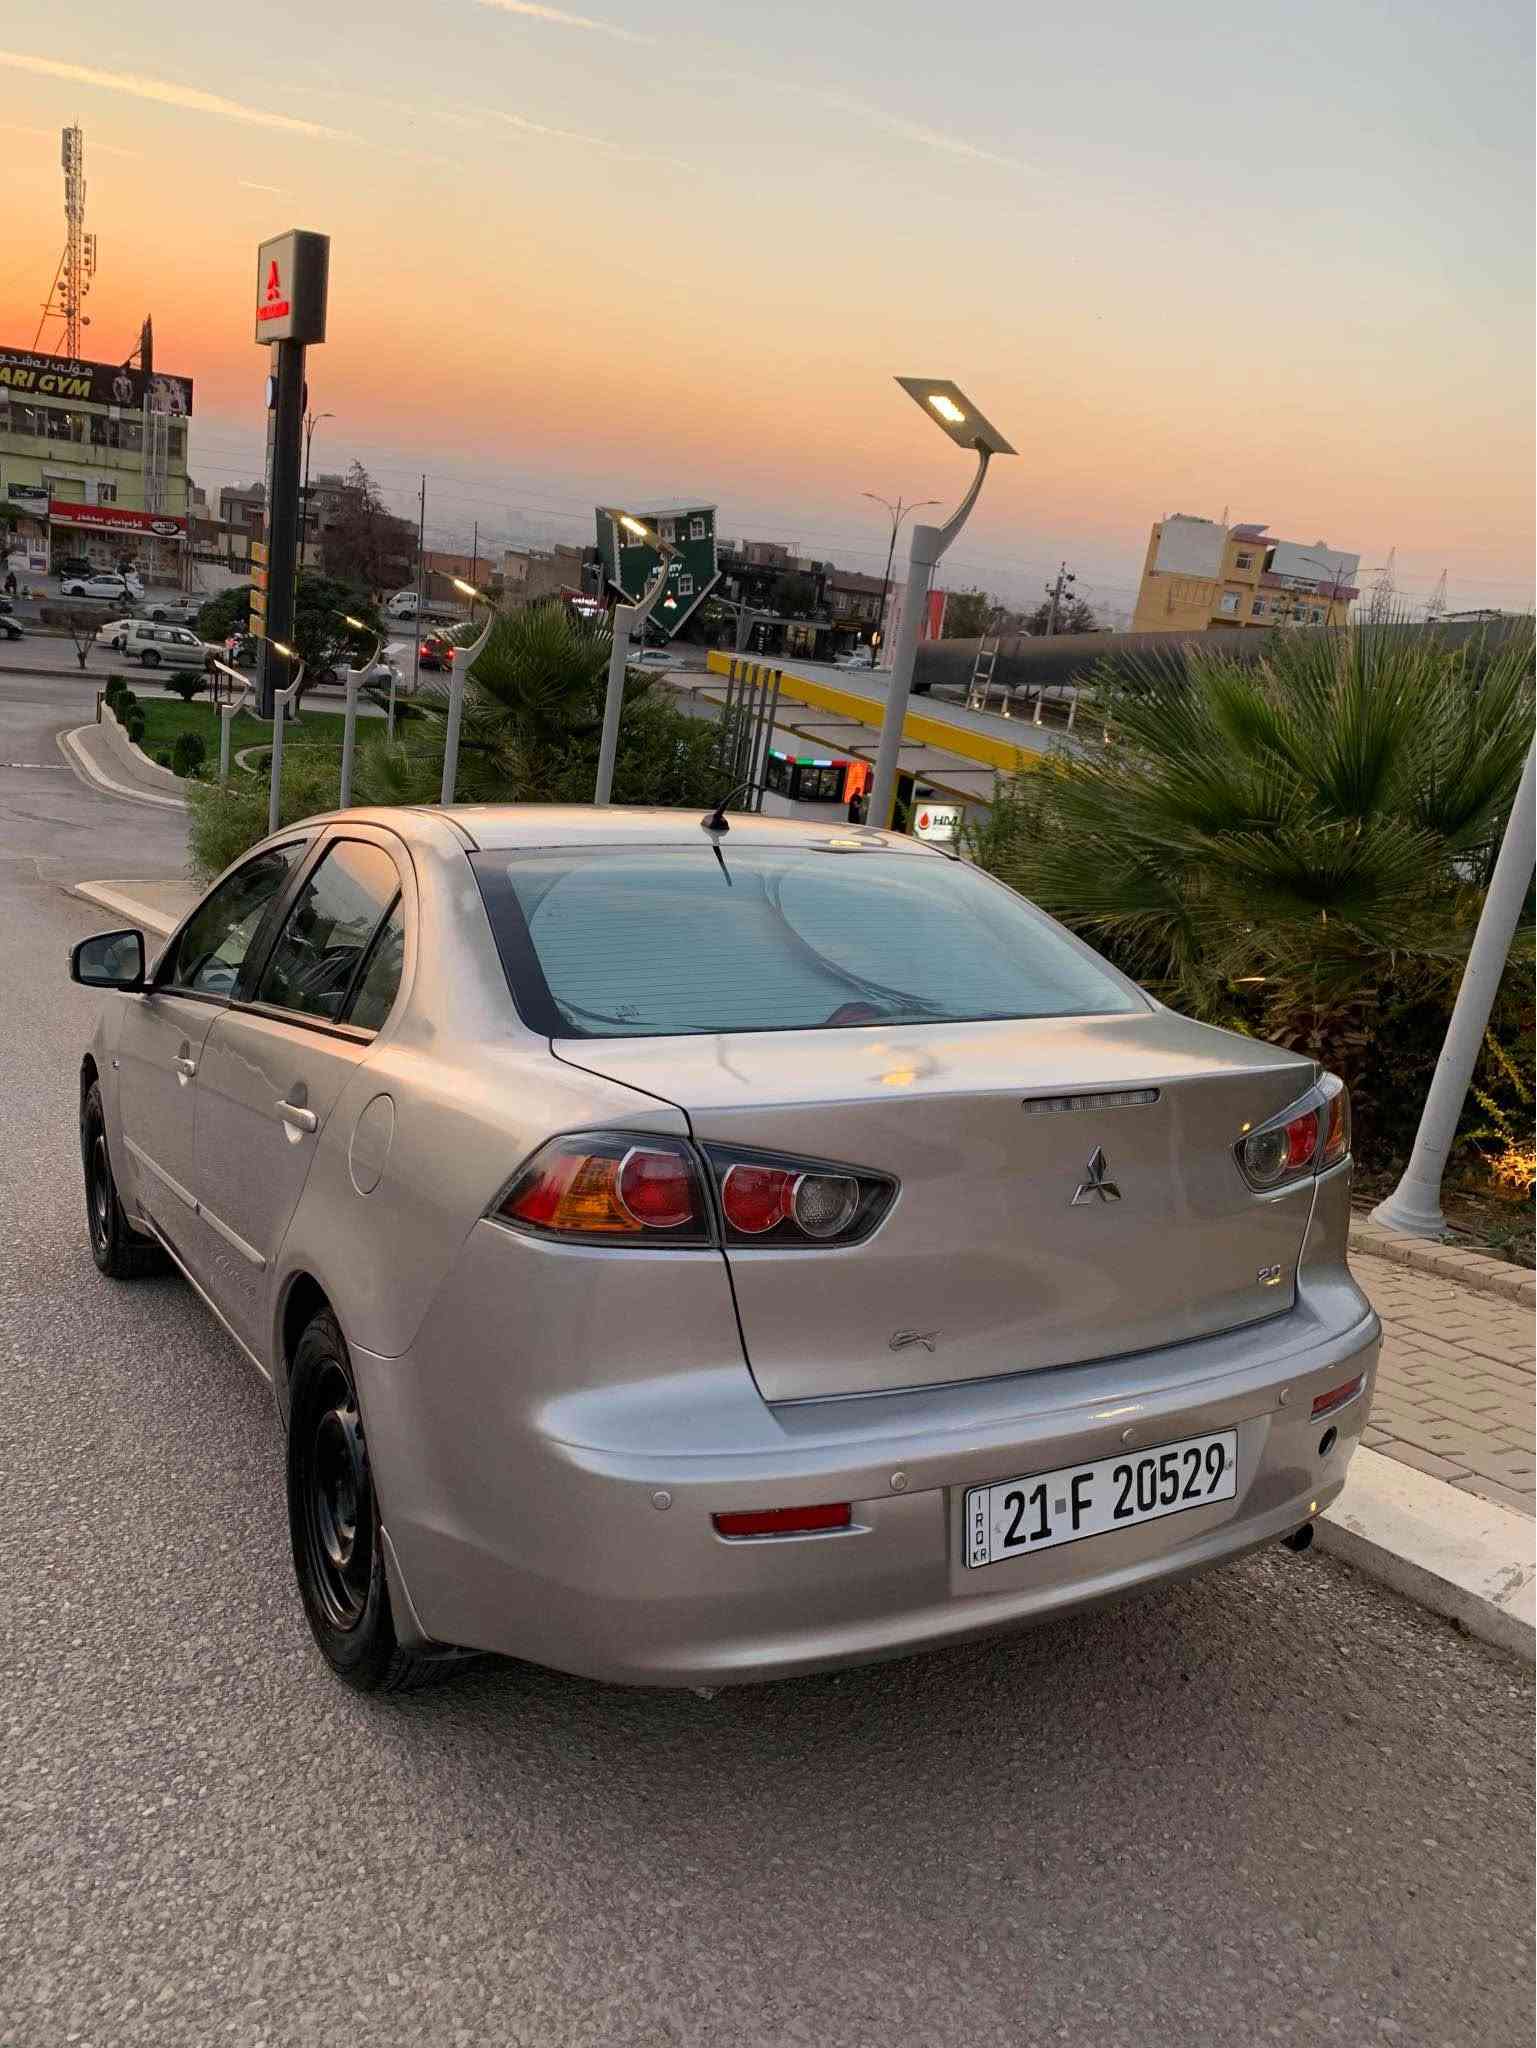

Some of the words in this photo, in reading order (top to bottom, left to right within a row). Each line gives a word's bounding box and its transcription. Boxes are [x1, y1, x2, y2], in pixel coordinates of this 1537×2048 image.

[0, 366, 36, 387] ARI
[39, 374, 92, 398] GYM
[1003, 1483, 1053, 1549] 21
[1070, 1472, 1096, 1531] F
[1112, 1441, 1226, 1521] 20529
[972, 1547, 987, 1562] KR
